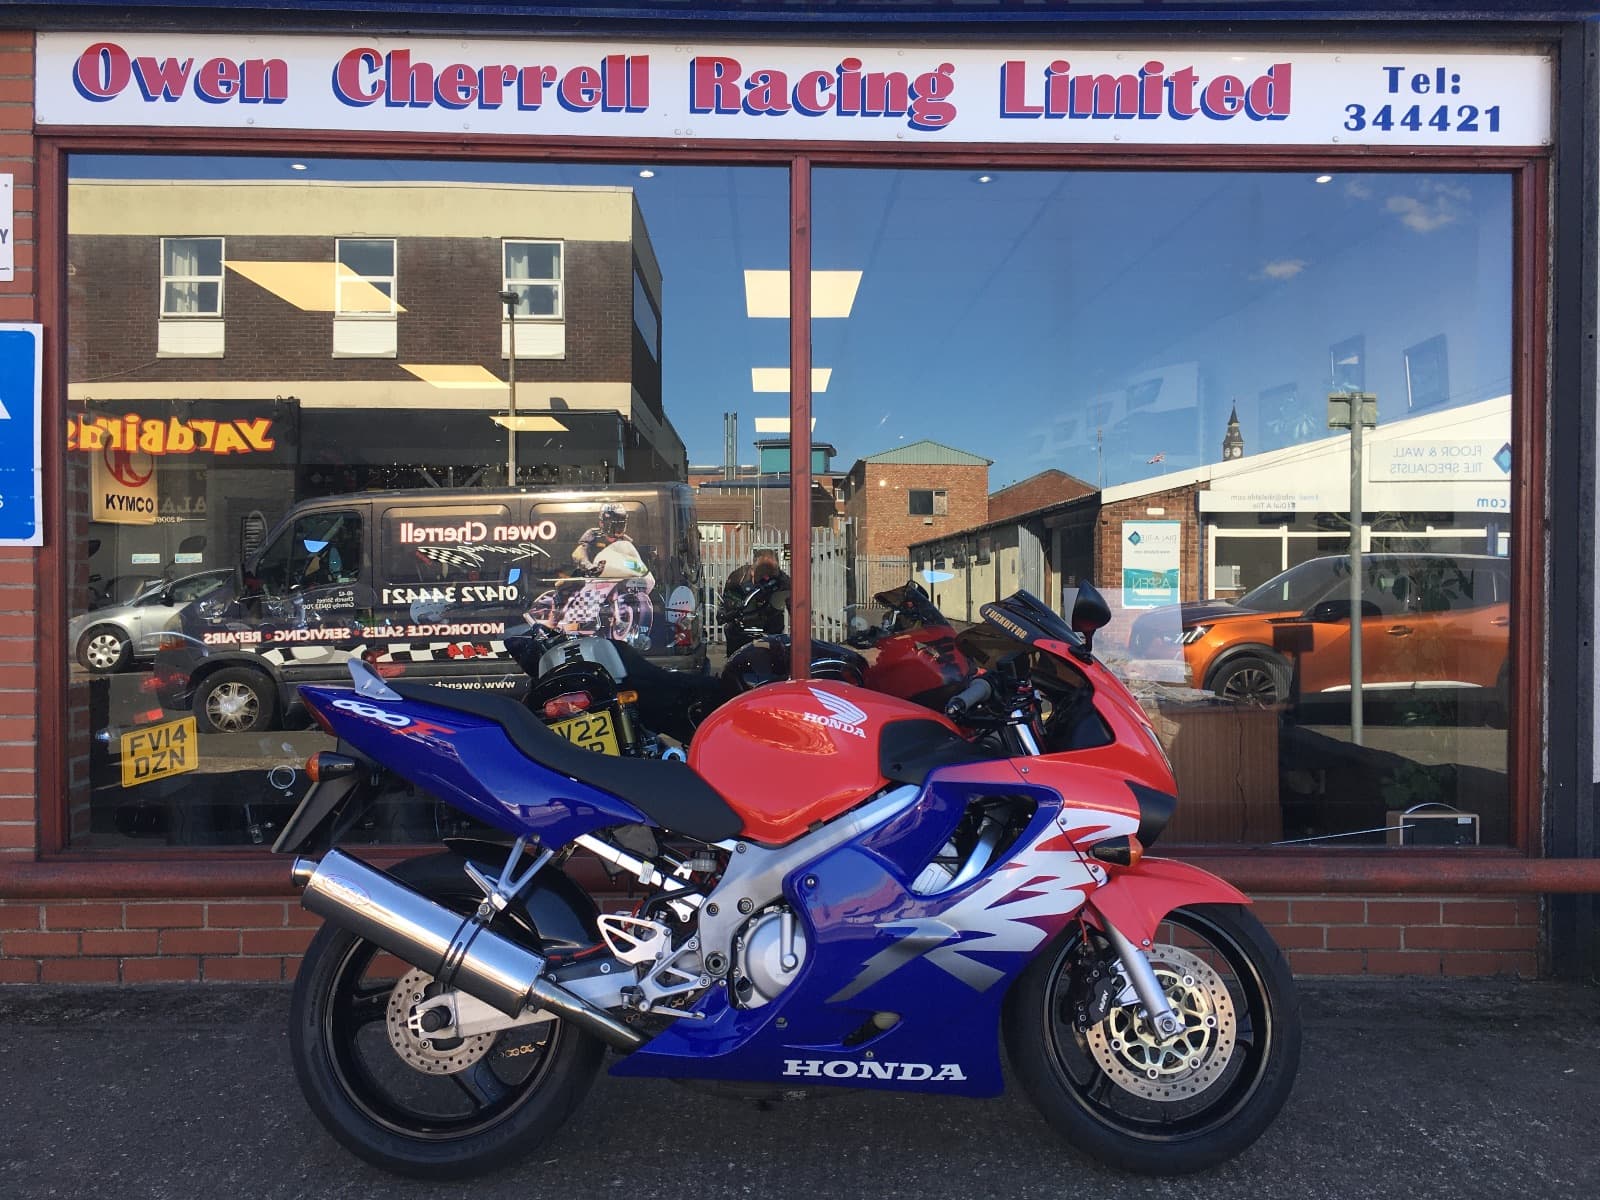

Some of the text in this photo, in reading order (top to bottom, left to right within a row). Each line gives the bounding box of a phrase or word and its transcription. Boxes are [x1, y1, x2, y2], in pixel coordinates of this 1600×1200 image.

[73, 42, 1292, 131] Owen Cherrell Racing Limited
[1382, 66, 1462, 95] Tel:
[1343, 104, 1502, 133] 344421
[105, 493, 154, 514] KYMCO
[802, 712, 867, 739] HONDA
[129, 724, 187, 757] FV14
[134, 746, 186, 778] DZN
[782, 1059, 968, 1081] HONDA
